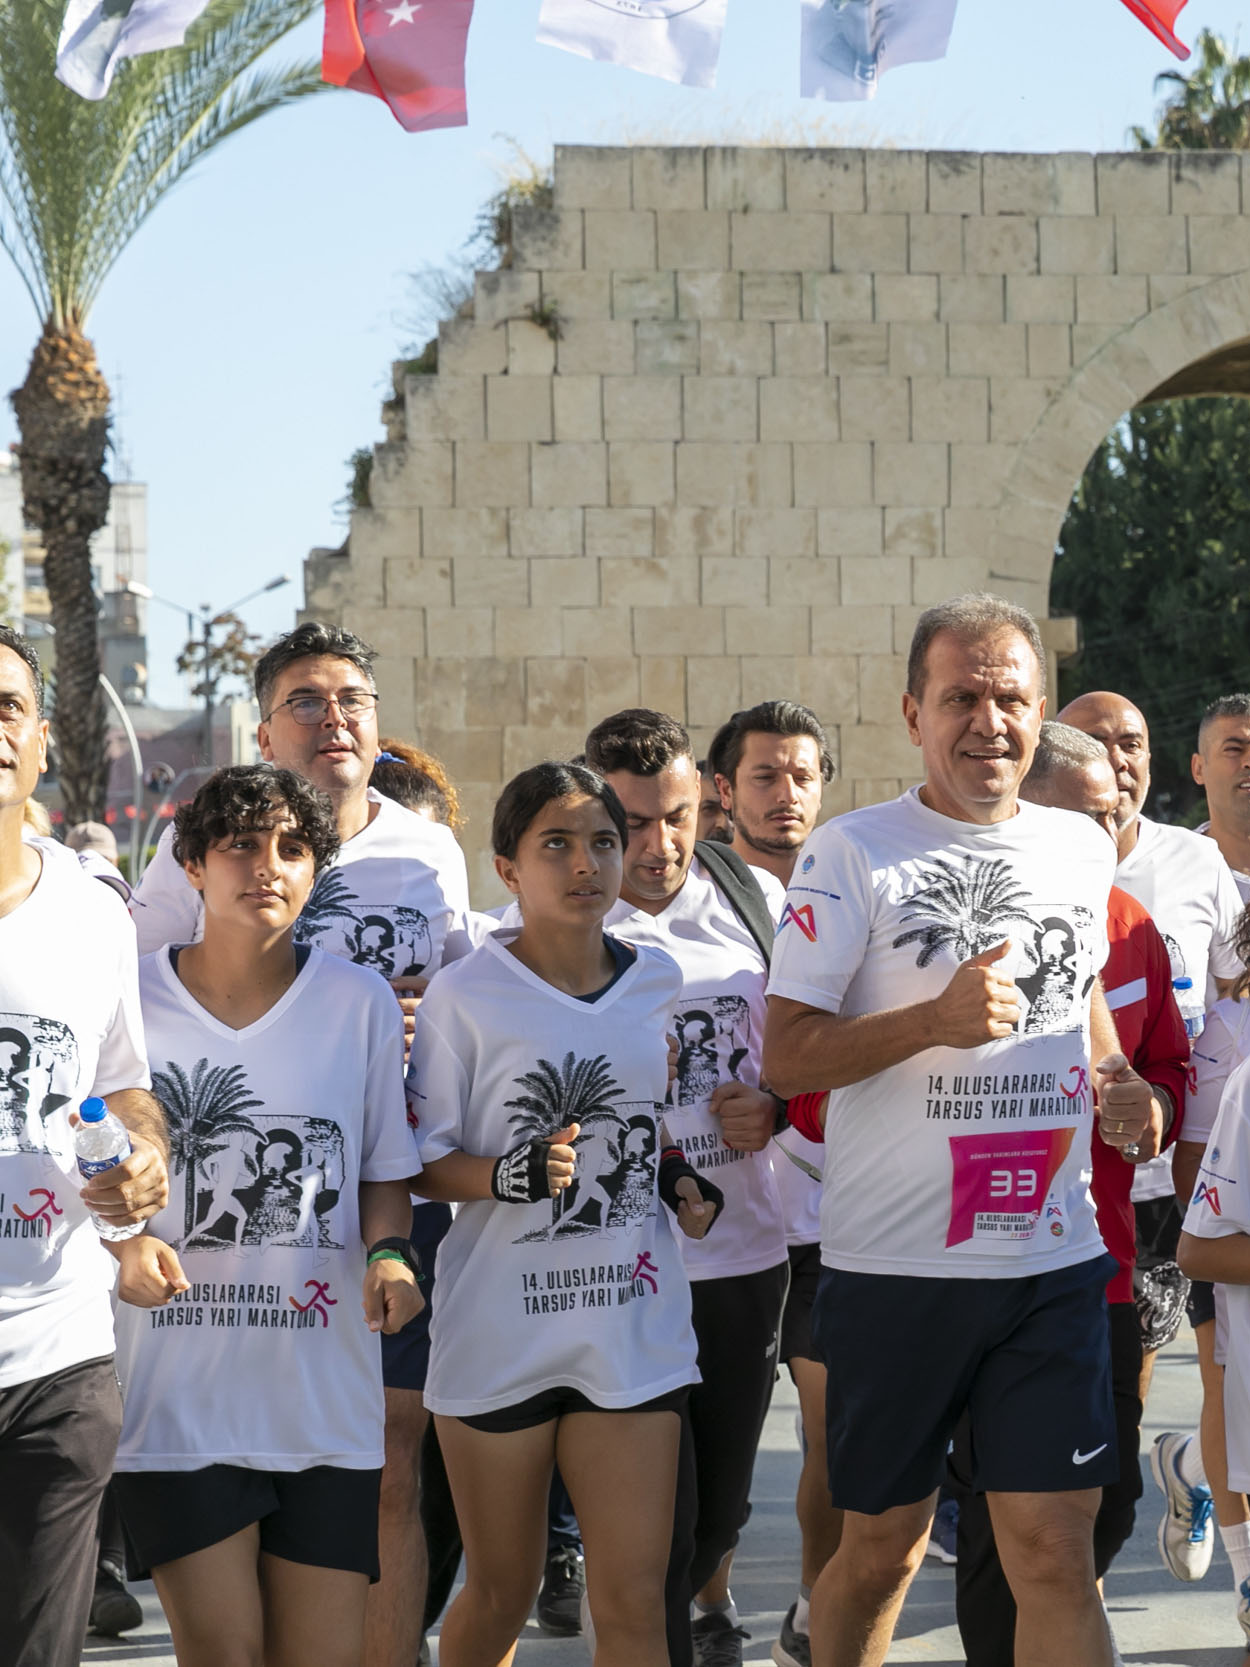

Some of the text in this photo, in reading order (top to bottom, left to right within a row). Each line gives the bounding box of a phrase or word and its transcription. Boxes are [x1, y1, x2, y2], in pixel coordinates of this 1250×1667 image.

[928, 1073, 1056, 1095] 14. ULUSLARARASI
[926, 1096, 1082, 1120] TARSUS YARI MARATONU
[989, 1169, 1037, 1197] 33
[522, 1273, 543, 1293] 14.
[523, 1292, 576, 1315] TARSUS
[582, 1288, 611, 1308] YARI
[151, 1307, 316, 1329] TARSUS YARI MARATONU
